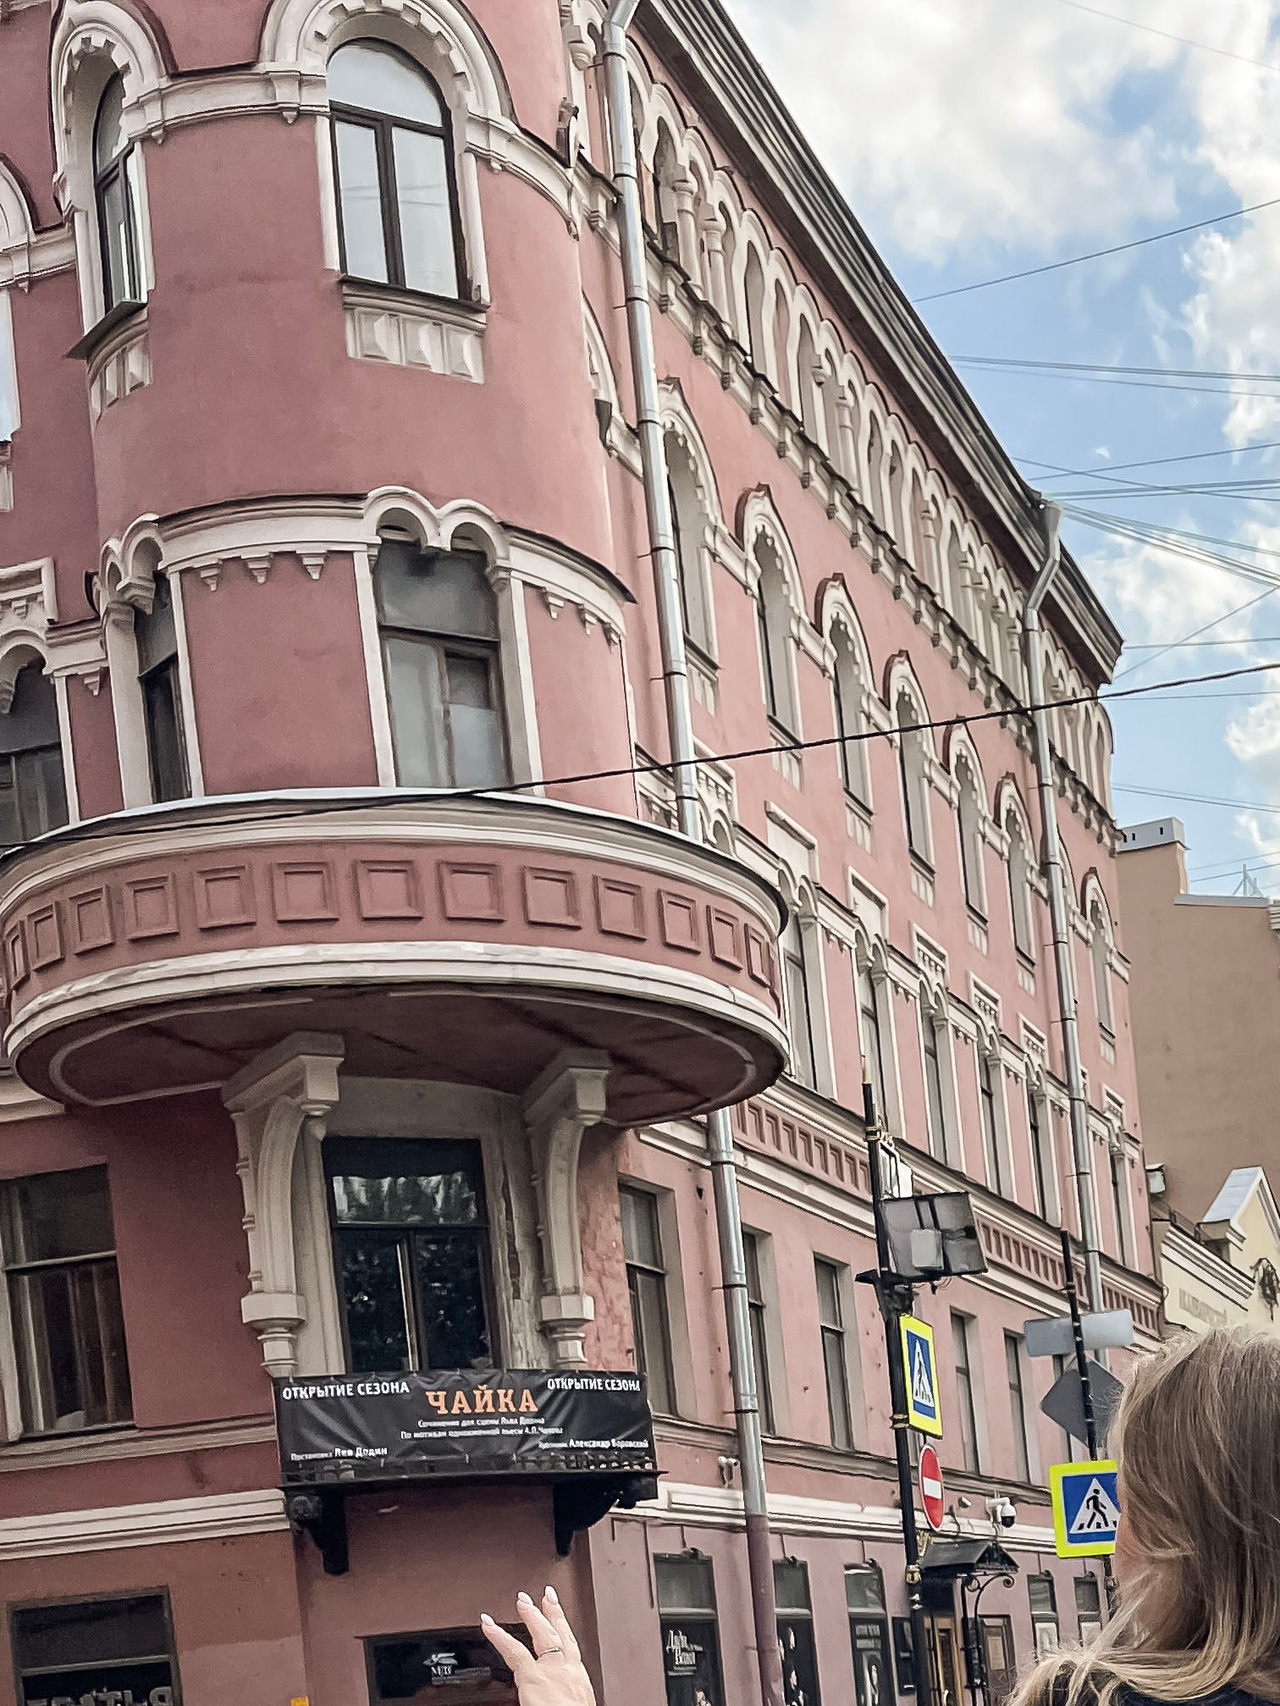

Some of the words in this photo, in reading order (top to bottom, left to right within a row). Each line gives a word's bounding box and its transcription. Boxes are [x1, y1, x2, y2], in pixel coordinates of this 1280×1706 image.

[282, 1383, 354, 1400] ОТКРЫТИЕ
[356, 1381, 410, 1396] СЕЗОНА
[547, 1378, 604, 1390] ОТКРЫТИЕ
[424, 1384, 539, 1415] ЧАЙКА
[355, 1446, 388, 1458] Додин
